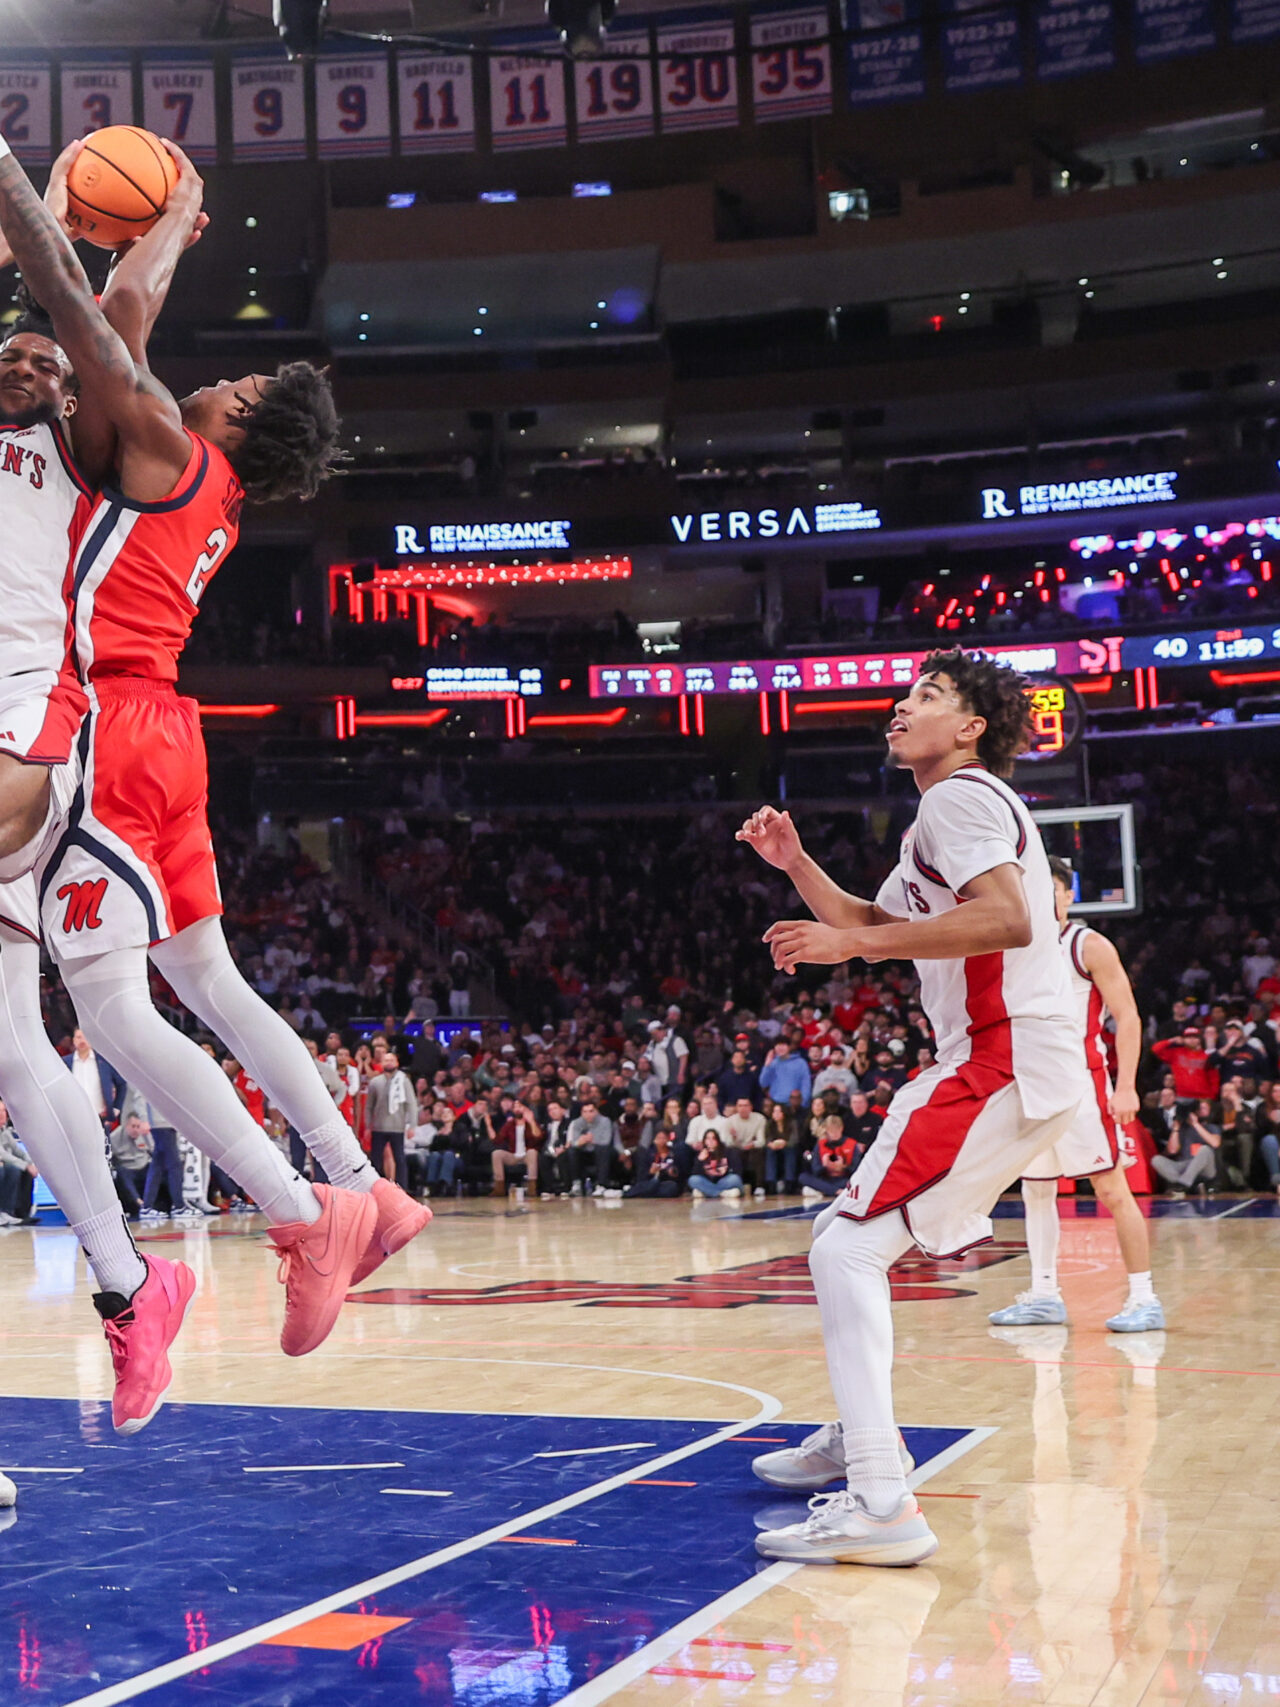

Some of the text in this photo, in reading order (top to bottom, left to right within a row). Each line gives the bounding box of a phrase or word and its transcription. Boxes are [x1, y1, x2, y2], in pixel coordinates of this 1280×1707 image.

[586, 63, 641, 117] 19
[667, 55, 731, 106] 30
[758, 46, 825, 95] 35
[0, 92, 30, 141] 2
[83, 93, 111, 135] 3
[163, 92, 194, 141] 7
[253, 88, 283, 137] 9
[337, 84, 367, 133] 9
[413, 80, 459, 131] 11
[505, 74, 551, 126] 11
[1020, 472, 1171, 506] RENAISSANCE
[1021, 502, 1050, 515] NEW
[1050, 499, 1082, 512] YORK
[1137, 489, 1177, 503] HOTEL
[429, 520, 565, 542] RENAISSANCE
[430, 541, 456, 553] NEW
[457, 540, 485, 552] YORK
[535, 536, 570, 549] HOTEL
[670, 506, 811, 542] VERSA
[185, 527, 228, 607] 2
[426, 667, 463, 680] OHIO
[464, 667, 508, 680] STATE
[1153, 638, 1188, 659] 40
[1198, 637, 1265, 661] 11:59
[686, 678, 715, 692] 17.6
[772, 674, 802, 688] 71.4
[869, 670, 881, 683] 4
